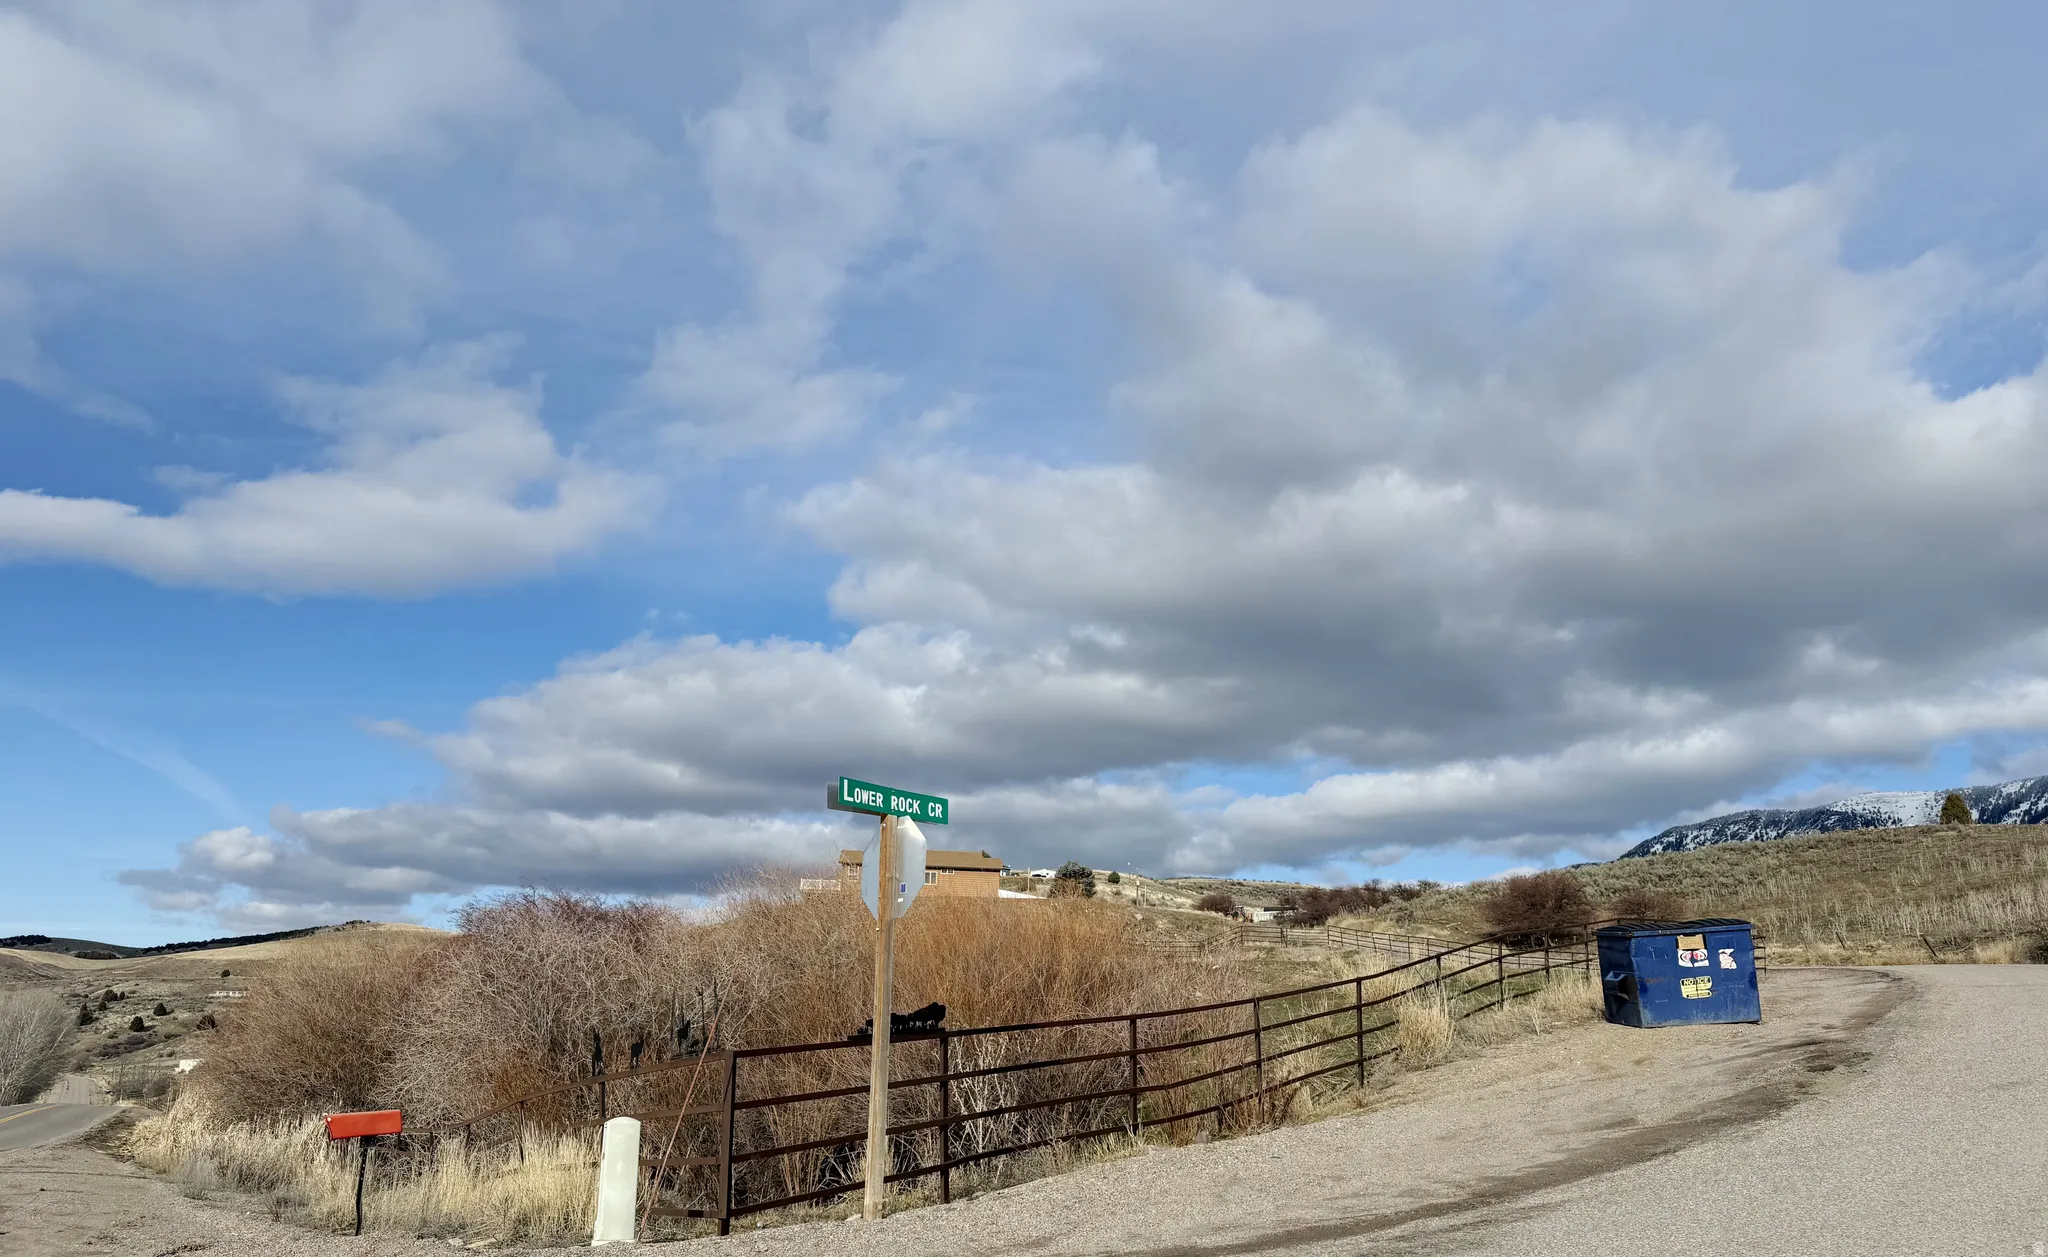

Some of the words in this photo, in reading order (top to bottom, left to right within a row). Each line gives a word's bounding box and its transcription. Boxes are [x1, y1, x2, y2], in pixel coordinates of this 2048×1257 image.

[843, 779, 884, 807] LOWER
[891, 795, 921, 814] ROCK
[928, 802, 943, 818] CR
